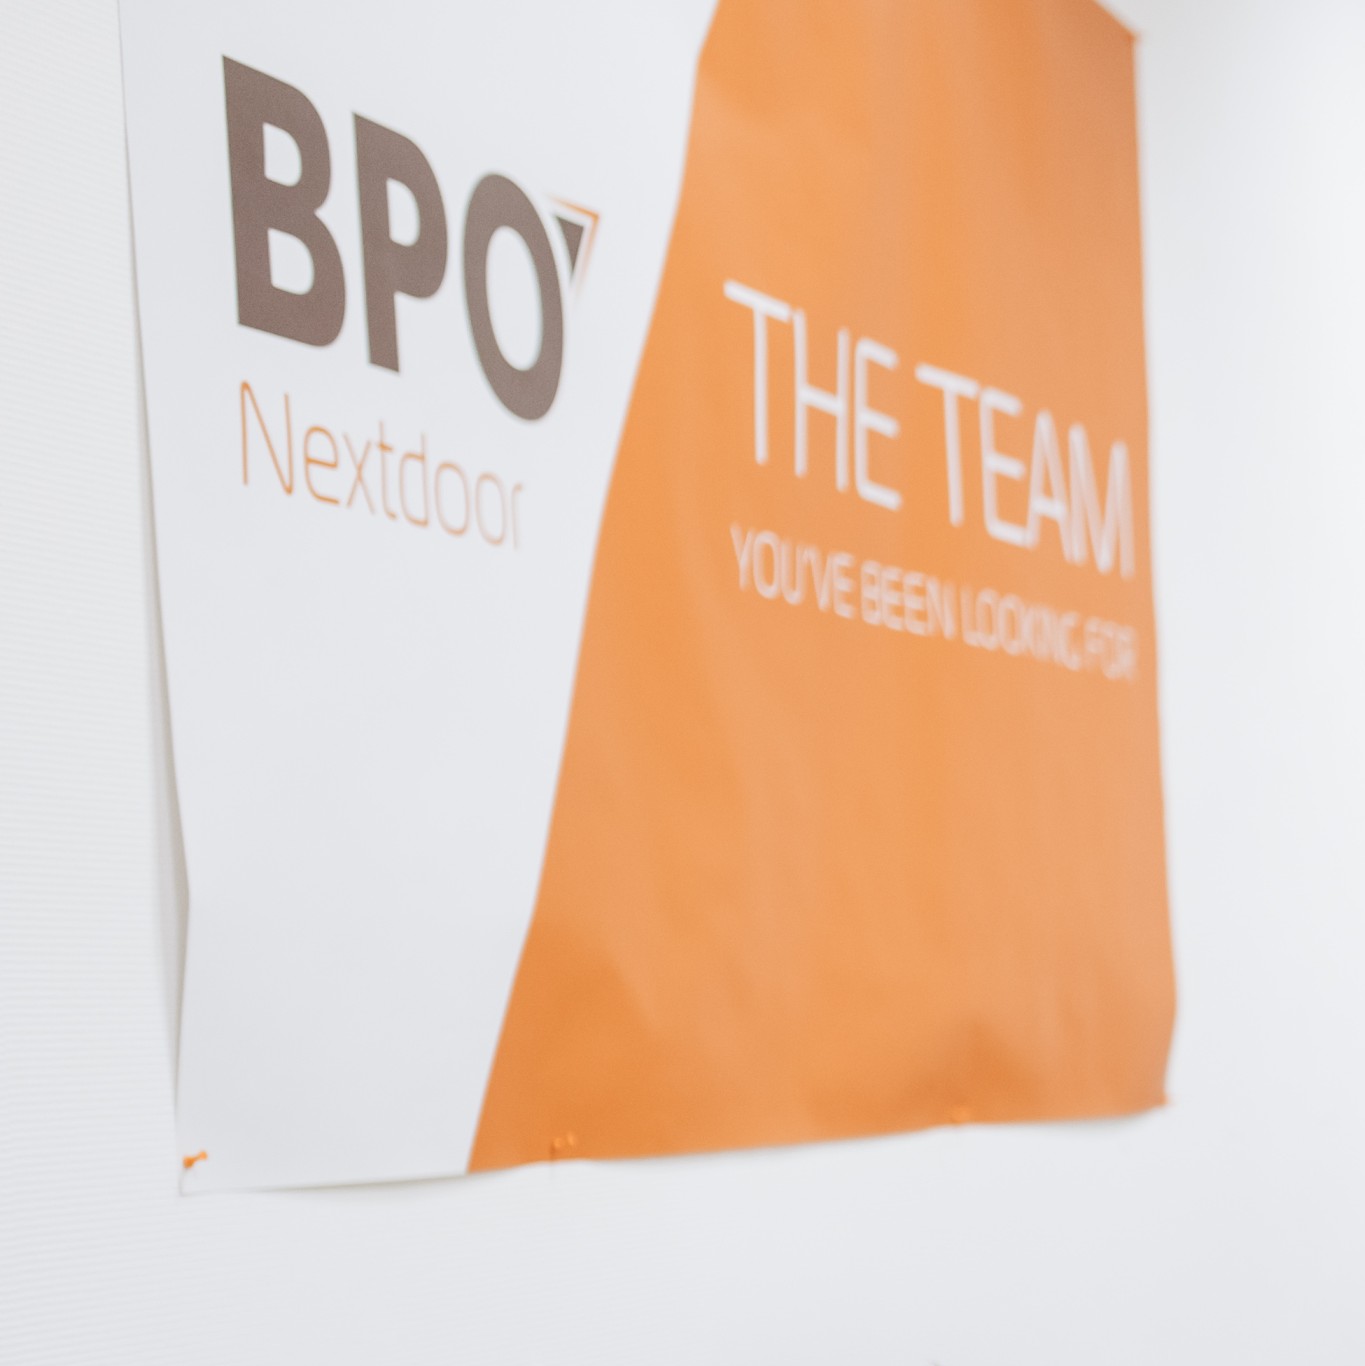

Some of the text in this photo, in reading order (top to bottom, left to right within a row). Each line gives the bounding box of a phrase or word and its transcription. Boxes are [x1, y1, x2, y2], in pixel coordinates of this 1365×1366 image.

[222, 54, 564, 422] BPO
[240, 379, 524, 550] Nextdoor
[723, 278, 1136, 581] THE TEAM
[729, 521, 1139, 683] YOU'VE BEEN LOOKING FOR
